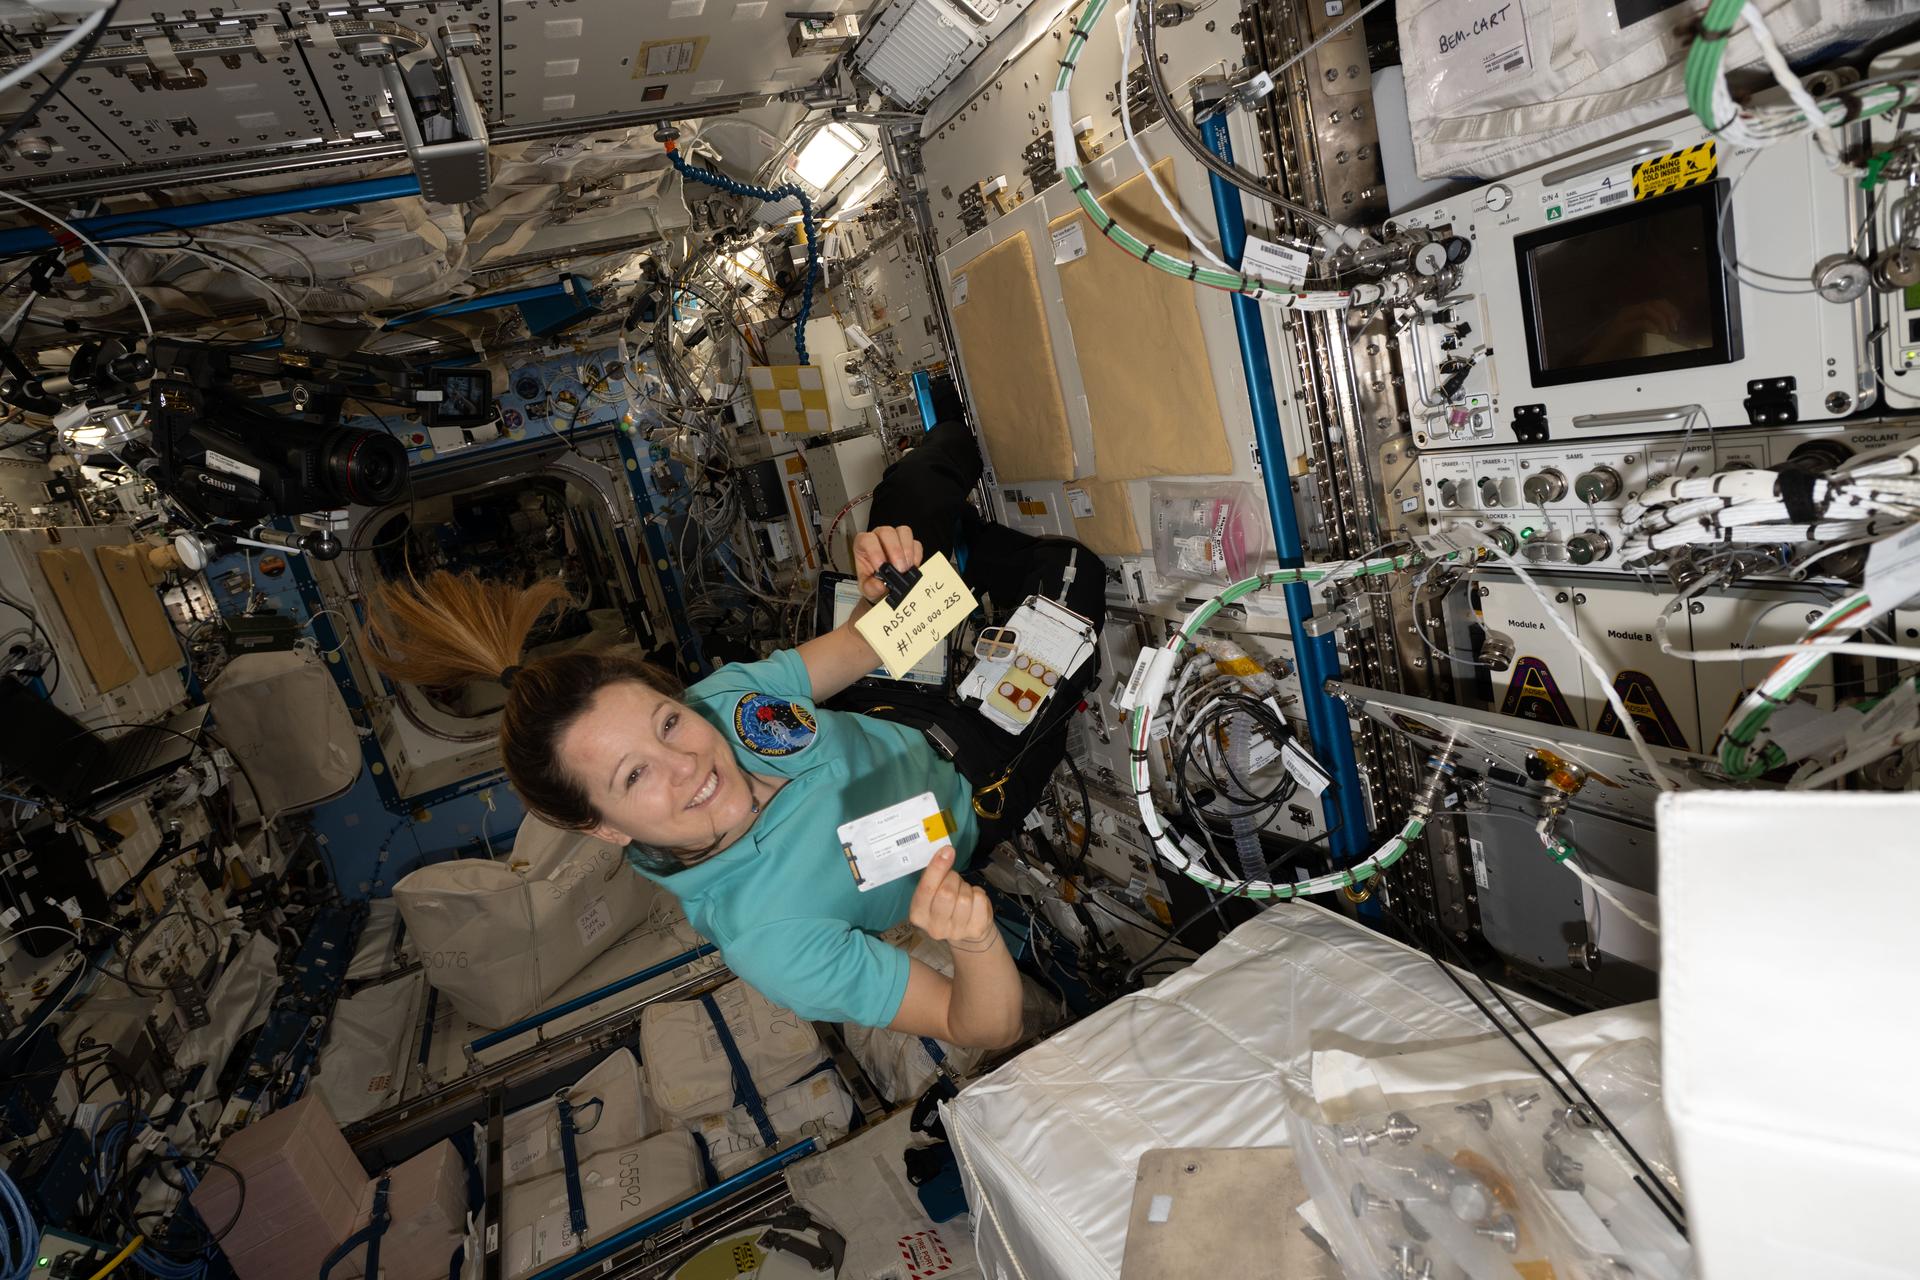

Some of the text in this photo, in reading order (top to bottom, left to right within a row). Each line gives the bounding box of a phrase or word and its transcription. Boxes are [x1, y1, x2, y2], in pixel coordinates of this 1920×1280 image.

[1439, 3, 1511, 54] BEM-CART
[1642, 158, 1680, 175] WARNING
[1642, 166, 1681, 183] COLD INSIDE
[1601, 177, 1612, 189] 4
[1542, 192, 1559, 203] S/N 4
[1851, 433, 1899, 443] COOLANT
[1686, 445, 1712, 453] APTOP
[1565, 452, 1584, 460] SAMS
[198, 474, 236, 492] Canon
[882, 601, 917, 637] ADSEP
[1508, 619, 1546, 630] Module A
[1608, 629, 1653, 642] Module B
[922, 1250, 934, 1268] PORT
